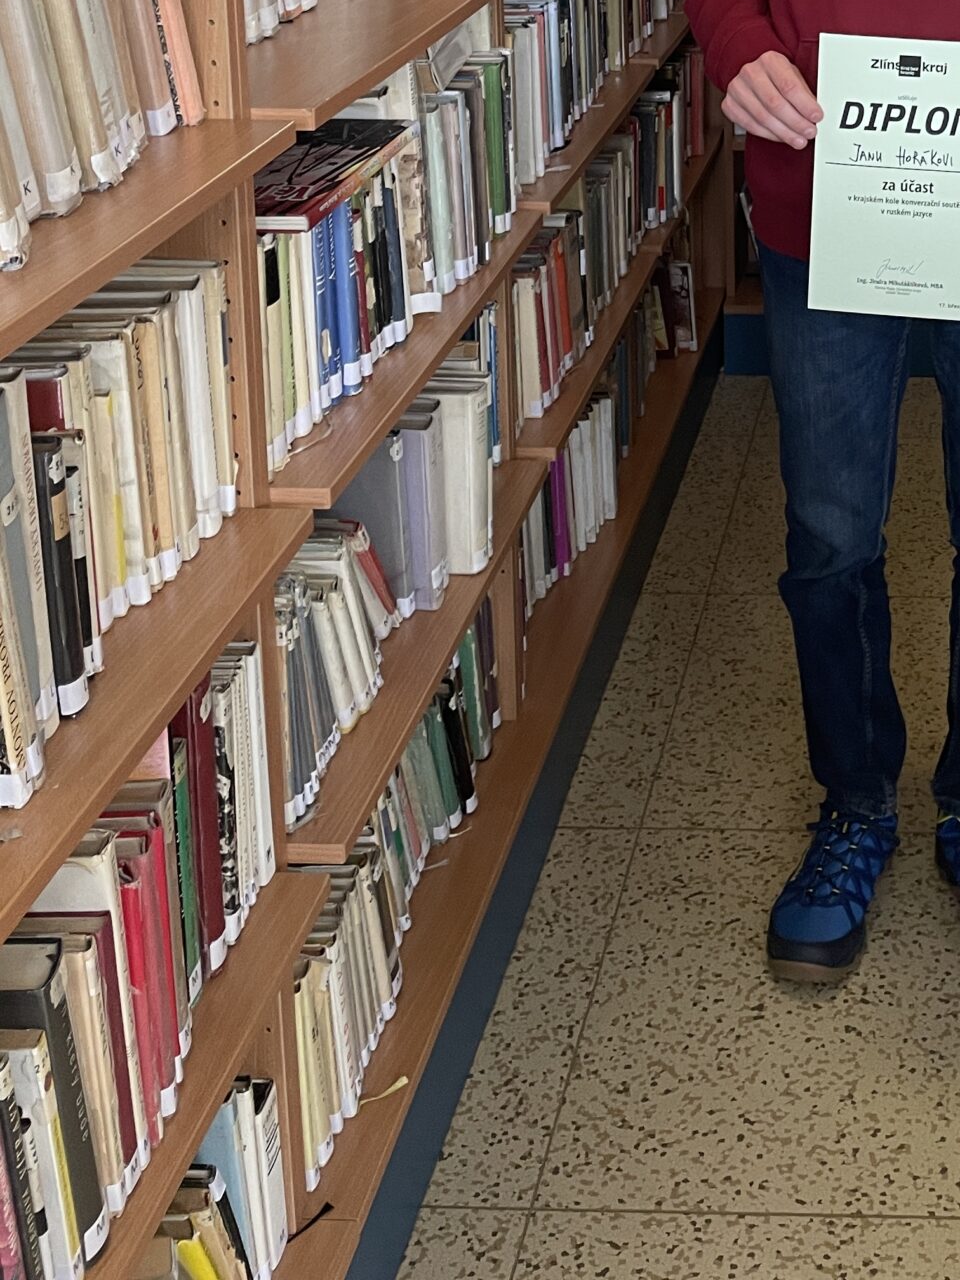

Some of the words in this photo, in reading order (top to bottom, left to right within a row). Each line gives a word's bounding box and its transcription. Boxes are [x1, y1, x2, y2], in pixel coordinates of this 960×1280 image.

[922, 61, 948, 75] kraj
[882, 181, 896, 192] za
[900, 179, 934, 194] účast
[853, 194, 884, 205] krajském
[885, 197, 899, 205] kole
[901, 197, 941, 208] konverzační
[886, 208, 911, 217] ruském
[912, 210, 933, 219] jazyce
